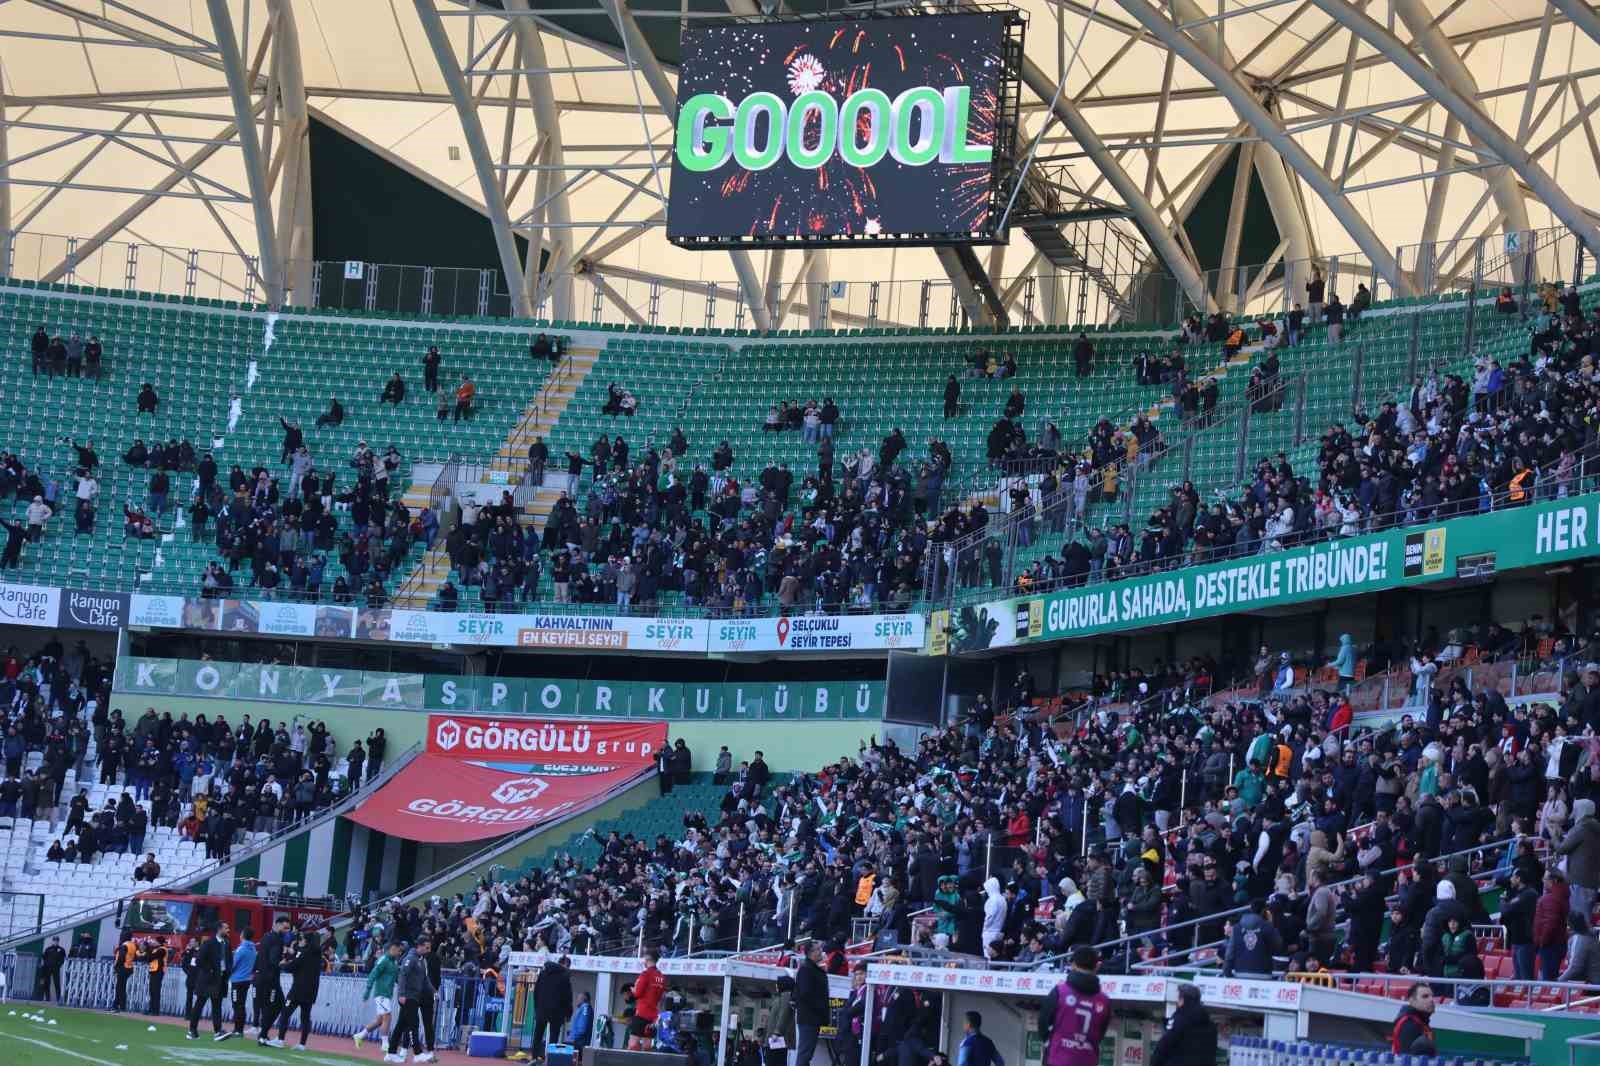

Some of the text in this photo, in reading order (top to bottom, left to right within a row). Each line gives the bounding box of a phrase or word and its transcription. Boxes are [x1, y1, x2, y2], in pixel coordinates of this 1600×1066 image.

[676, 86, 993, 172] GOOOOL
[1507, 233, 1517, 249] K
[349, 262, 359, 275] H
[1536, 507, 1588, 554] HER
[1048, 542, 1389, 631] GURURLA SAHADA, DESTEKLE TRİBÜNDE!
[17, 602, 47, 620] Cafe
[70, 592, 120, 614] Kanyon
[89, 608, 118, 626] Cafe
[535, 616, 613, 631] KAHVALTININ
[791, 618, 840, 633] SELÇUKLU
[523, 631, 541, 643] EN
[464, 721, 651, 757] GÖRGÜLÜ grup
[1075, 1008, 1092, 1034] 7
